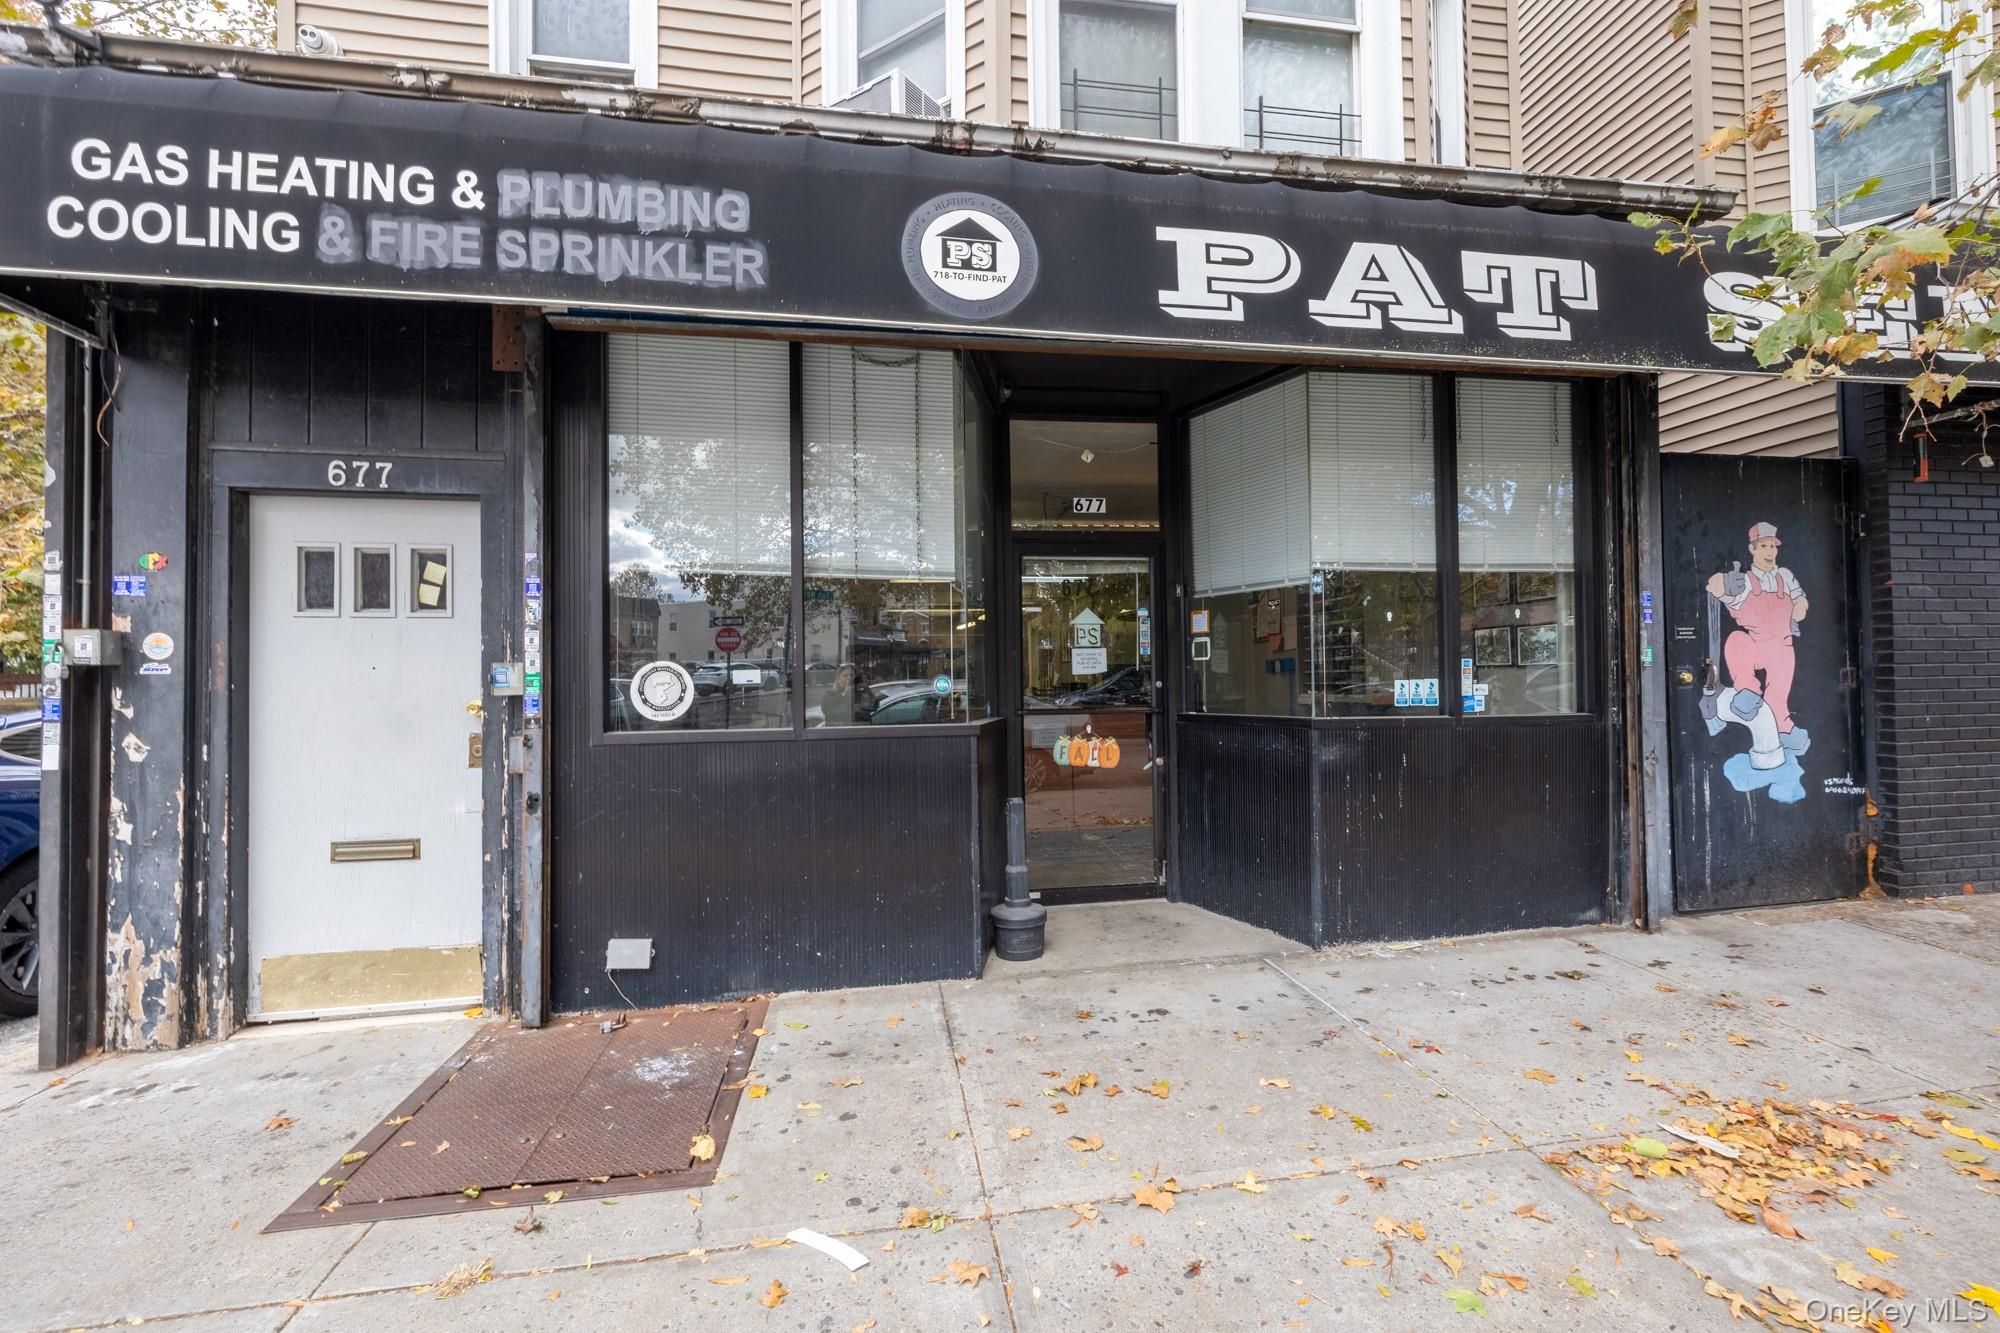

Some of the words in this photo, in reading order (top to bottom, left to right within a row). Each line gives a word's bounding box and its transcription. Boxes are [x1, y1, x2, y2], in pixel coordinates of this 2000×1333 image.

[70, 136, 189, 187] GAS
[207, 148, 434, 206] HEATING
[451, 170, 486, 209] &
[502, 173, 749, 231] PLUMBING
[46, 195, 301, 253] COOLING
[317, 216, 354, 257] &
[369, 218, 482, 267] FIRE
[499, 228, 766, 286] SPRINKLER
[946, 240, 993, 270] PS
[933, 270, 1007, 284] 718-TO-FIND-PAT
[1155, 226, 1599, 343] PAT
[327, 459, 393, 489] 677
[1074, 498, 1105, 512] 677
[1076, 626, 1098, 645] PS
[1059, 745, 1112, 761] FALL
